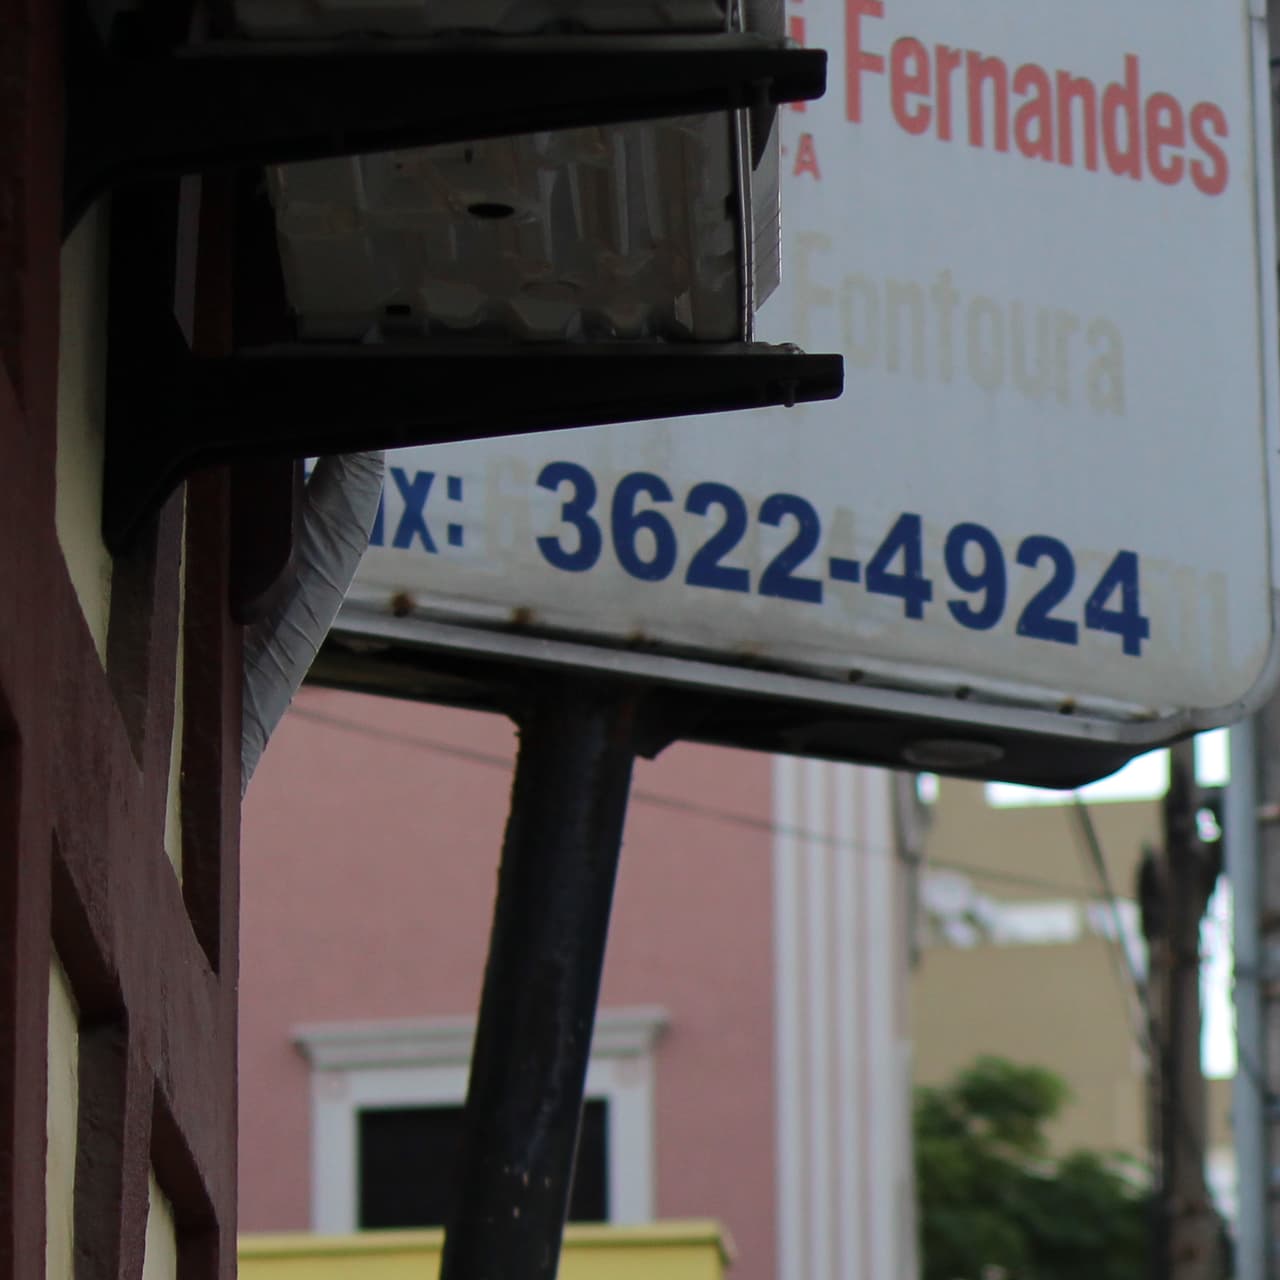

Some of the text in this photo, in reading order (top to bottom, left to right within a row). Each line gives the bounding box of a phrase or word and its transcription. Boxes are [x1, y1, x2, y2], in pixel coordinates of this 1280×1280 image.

[845, 0, 1229, 196] Fernandes
[790, 229, 1127, 417] Fontoura
[537, 460, 1152, 658] 3622-4924
